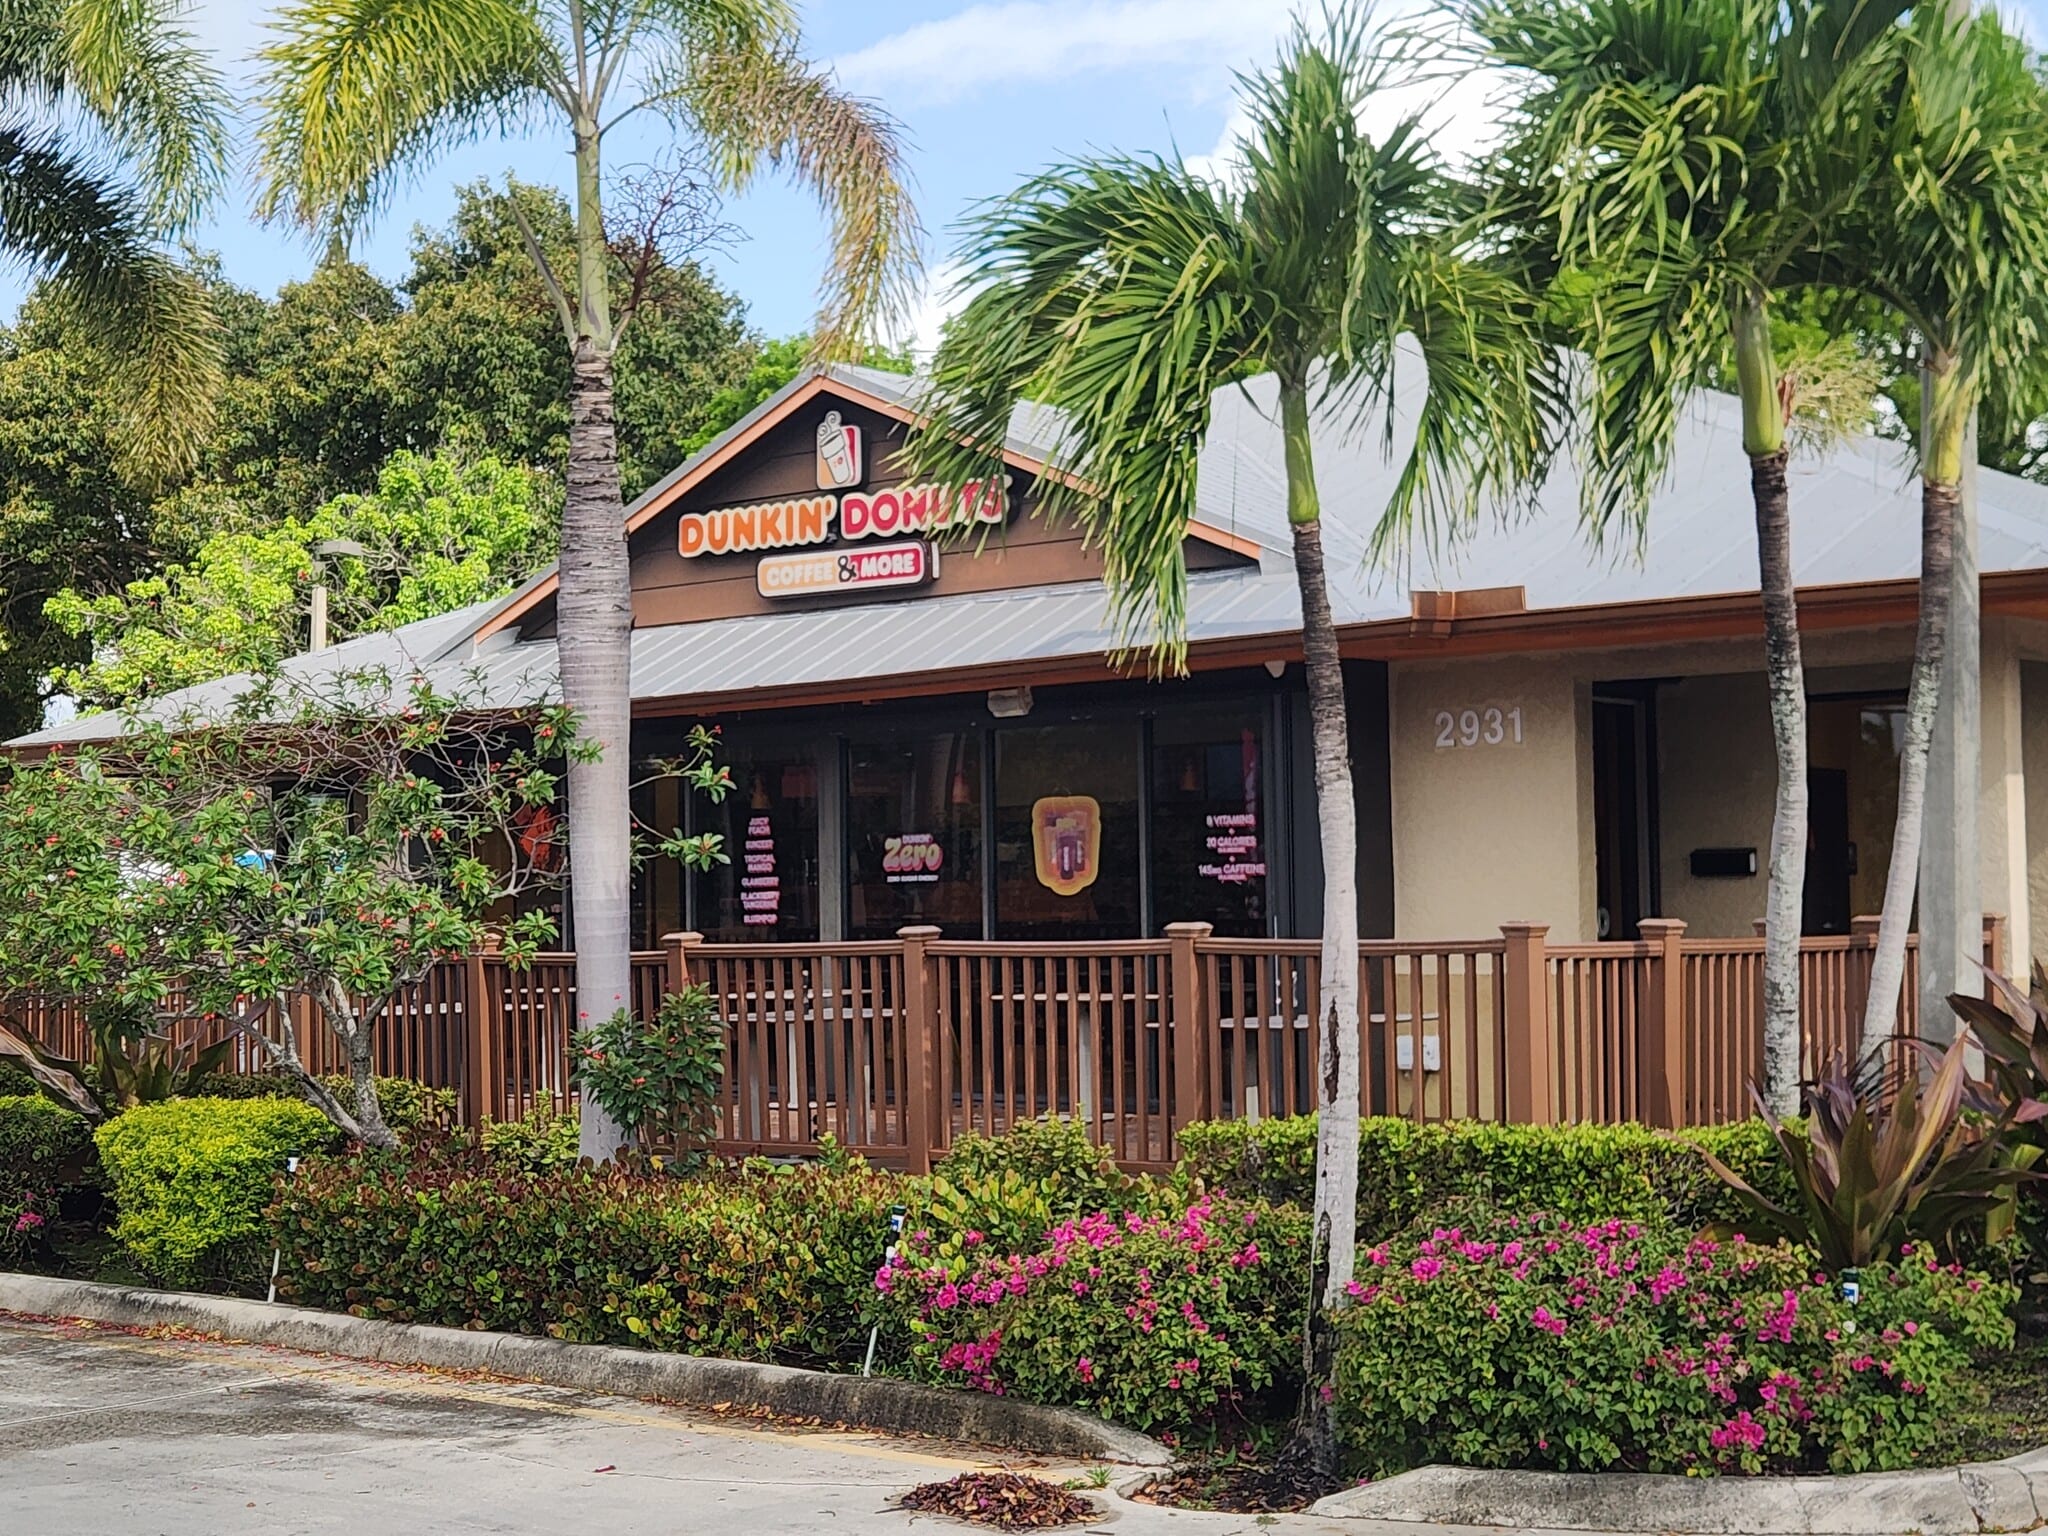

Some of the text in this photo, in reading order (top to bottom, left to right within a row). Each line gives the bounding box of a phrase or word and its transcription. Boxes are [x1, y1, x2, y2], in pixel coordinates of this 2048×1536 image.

[680, 498, 833, 554] DUNKIN'
[766, 552, 916, 586] COFFEE & MORE
[1435, 706, 1522, 748] 2931
[882, 838, 944, 872] Zero
